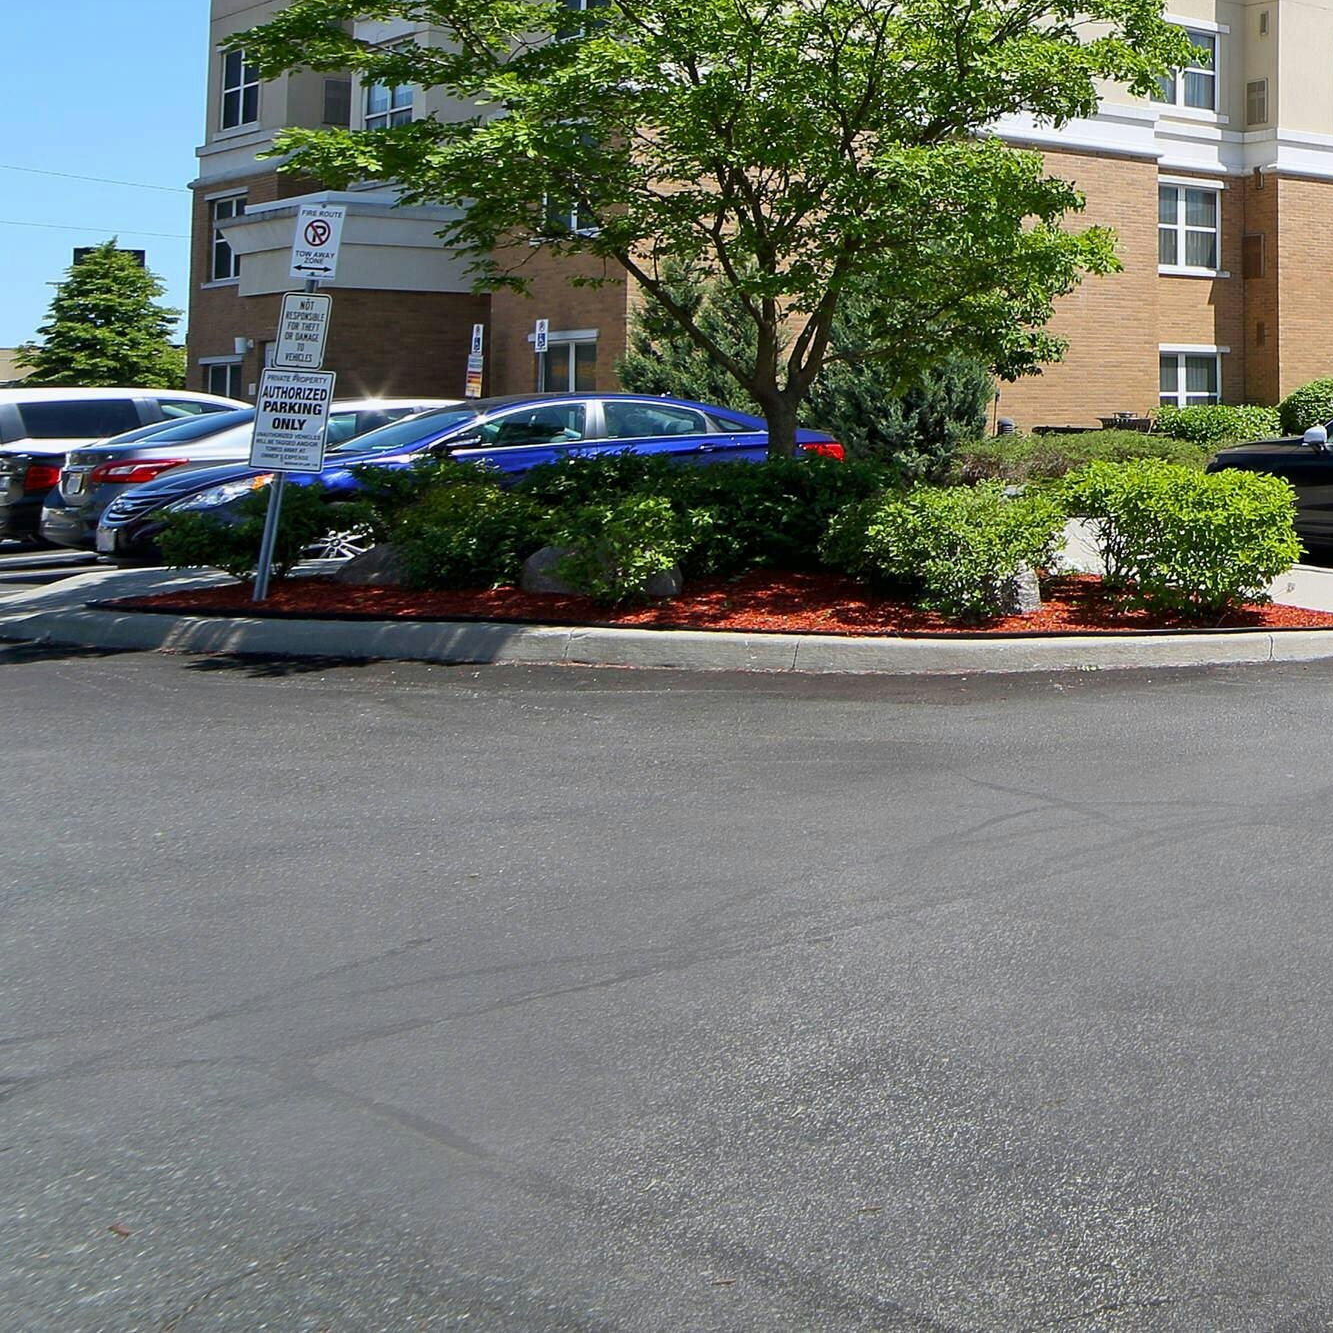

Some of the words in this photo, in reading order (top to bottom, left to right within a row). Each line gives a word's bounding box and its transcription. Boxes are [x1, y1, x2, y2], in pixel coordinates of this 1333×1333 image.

[301, 209, 318, 217] FIRE
[319, 210, 343, 219] ROUTE
[313, 251, 335, 259] AWAY
[303, 257, 323, 265] ZONE
[299, 300, 315, 311] NOT
[285, 311, 325, 322] RESPONSIBLE
[287, 321, 299, 330] FOR
[301, 322, 320, 332] THEFT
[284, 331, 293, 340] OR
[295, 332, 320, 342] DAMAGE
[284, 352, 313, 363] VEHICLES
[267, 374, 291, 382] PRIVATE
[292, 374, 327, 384] PROPERTY
[262, 385, 328, 402] AUTHORIZED
[263, 400, 322, 415] PARKING
[272, 417, 307, 431] ONLY
